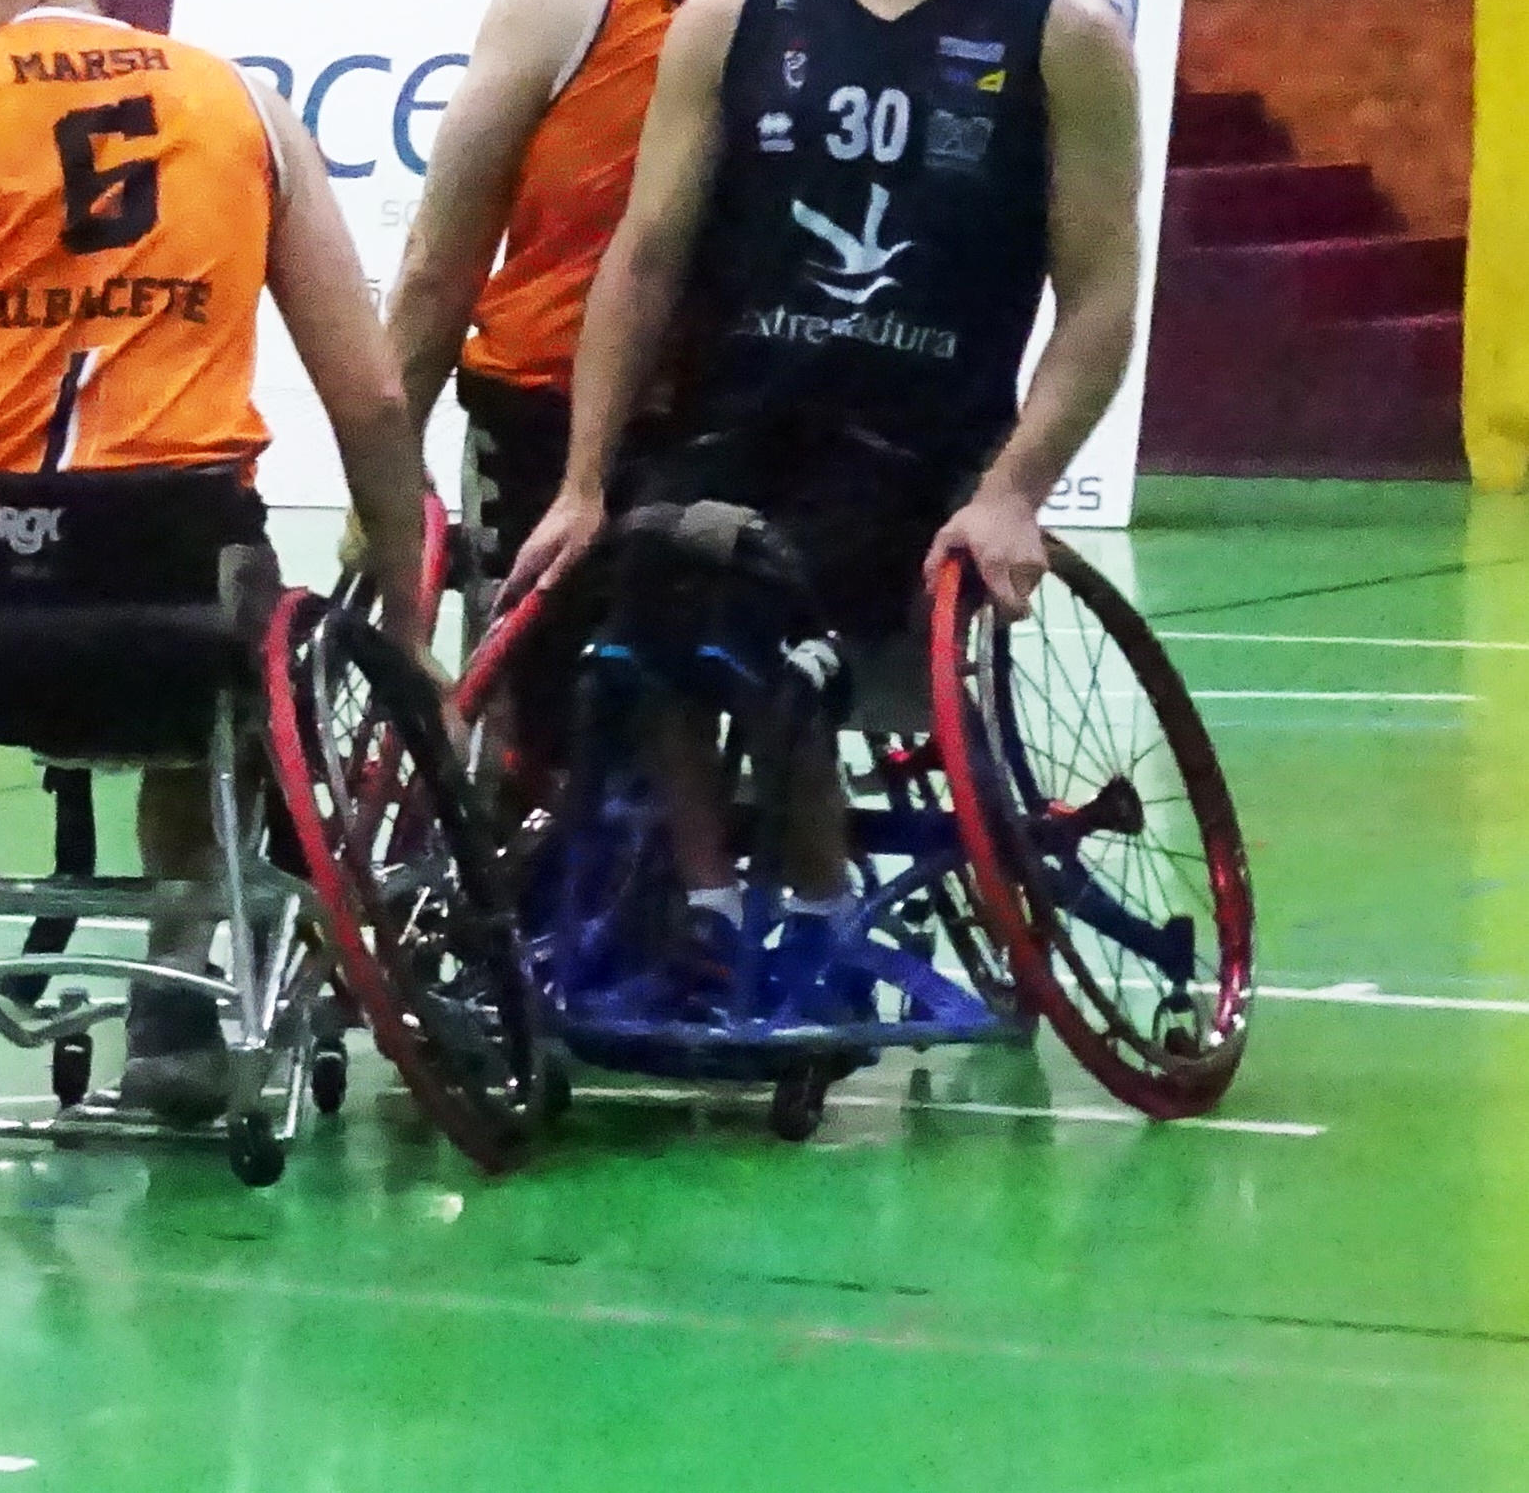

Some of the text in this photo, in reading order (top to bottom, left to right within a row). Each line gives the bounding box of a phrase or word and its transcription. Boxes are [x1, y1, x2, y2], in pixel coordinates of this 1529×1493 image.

[10, 47, 171, 84] MARSH
[825, 85, 911, 163] 30
[53, 93, 160, 255] 6
